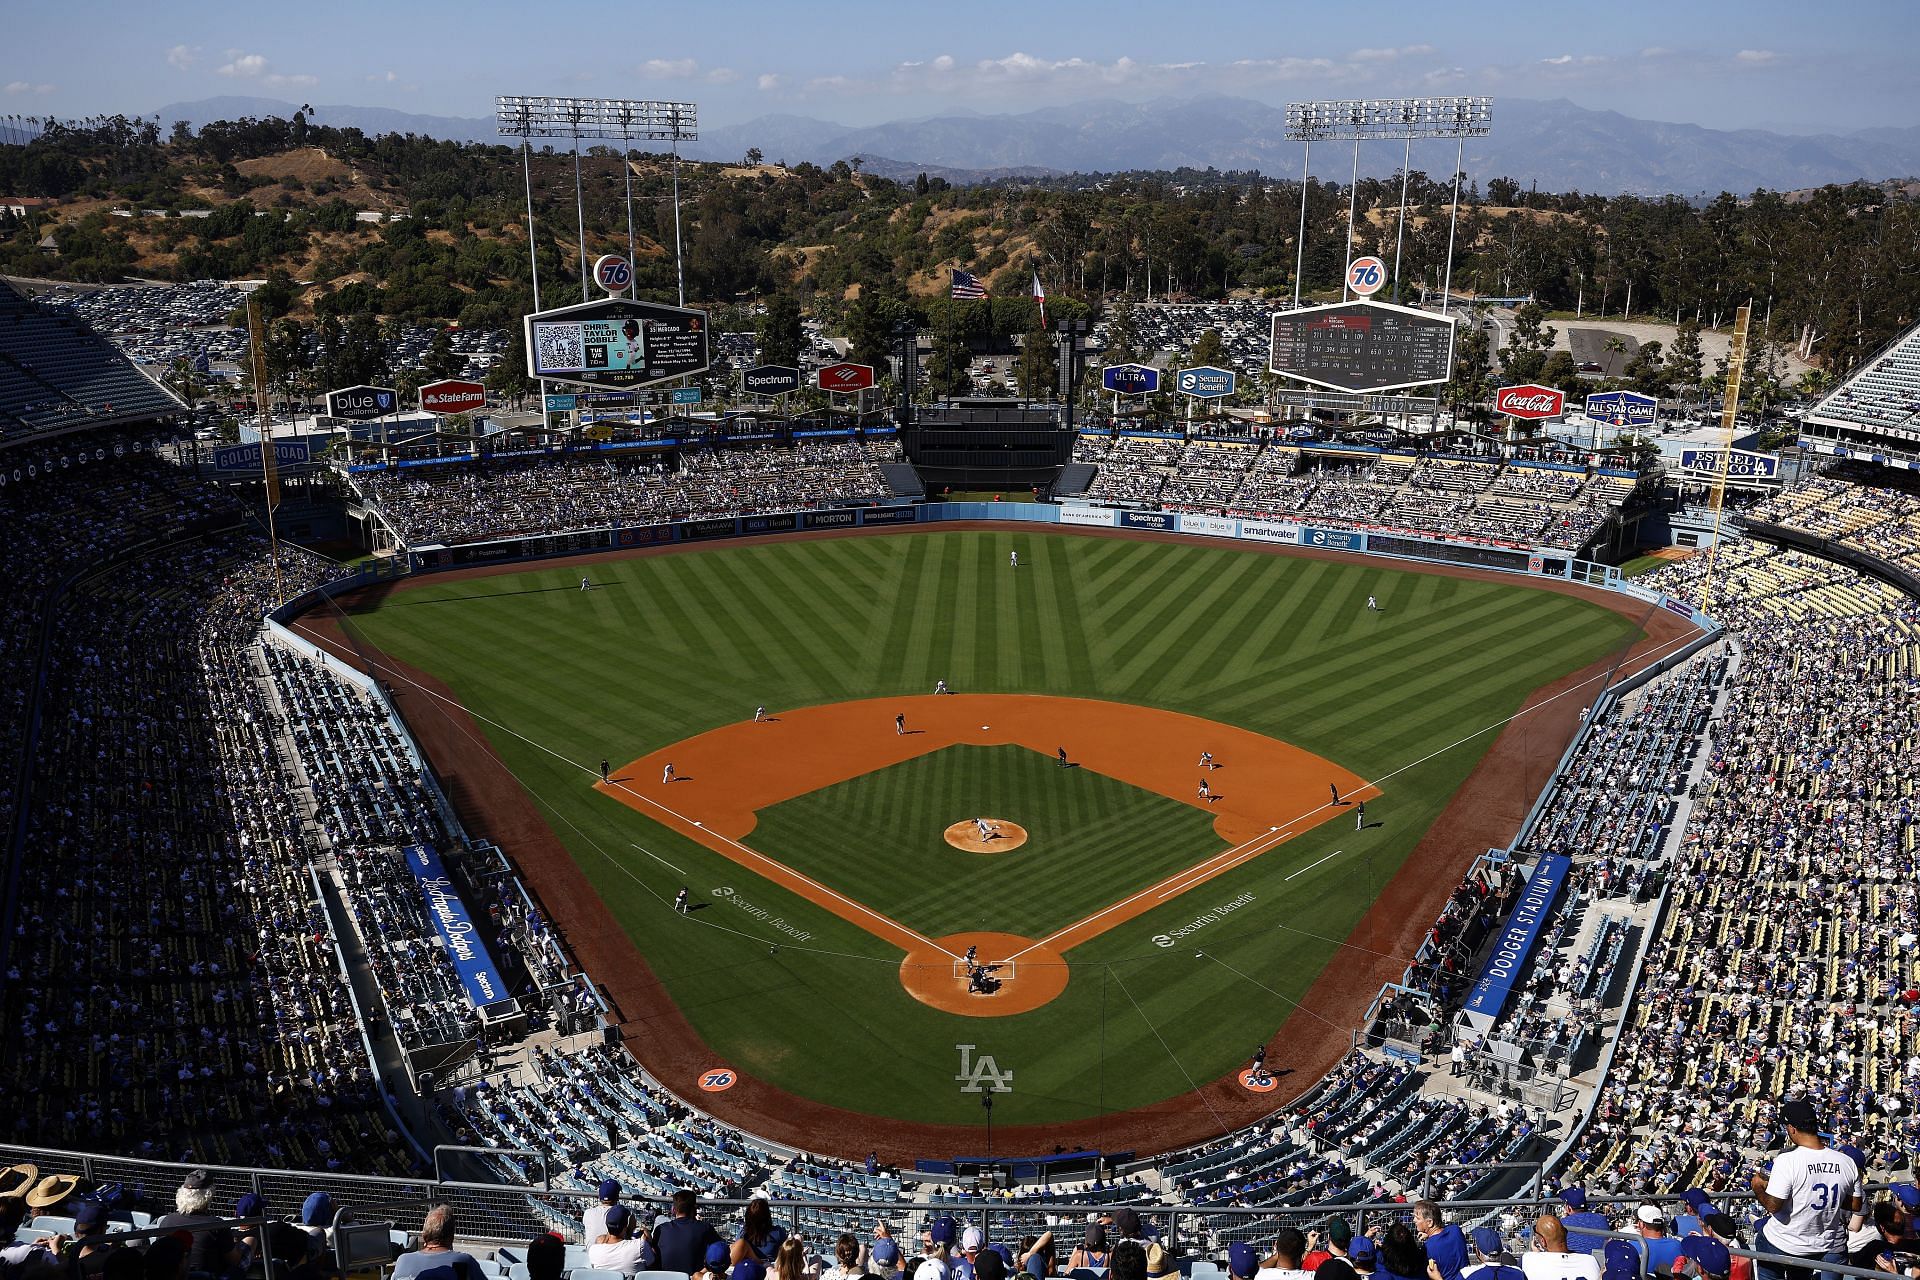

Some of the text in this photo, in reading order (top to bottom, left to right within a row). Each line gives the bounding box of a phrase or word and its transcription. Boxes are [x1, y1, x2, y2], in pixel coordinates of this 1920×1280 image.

[602, 262, 630, 284] 76
[1352, 264, 1380, 286] 76
[748, 375, 792, 386] Spectrum
[1115, 373, 1146, 382] ULTRA
[1199, 375, 1229, 384] Security
[1199, 383, 1225, 392] Benefit
[336, 395, 374, 409] blue
[1502, 392, 1556, 412] Coca-Cola
[1589, 403, 1653, 415] ALL STAR GAME
[344, 408, 378, 416] california
[220, 447, 262, 467] GOLDE
[273, 447, 304, 460] ROAD
[816, 514, 852, 523] MORTON
[1129, 514, 1162, 522] Spectrum
[1244, 527, 1296, 539] smartwater
[1327, 532, 1351, 542] Security
[1531, 560, 1541, 568] 76
[1517, 879, 1553, 924] STADIUM
[422, 877, 476, 960] Los Angeles Dodgers
[727, 894, 811, 942] Security Benefit
[1170, 892, 1256, 938] Security Benefit
[1490, 928, 1529, 978] DODGER
[475, 971, 495, 999] Spectrum
[955, 1044, 1013, 1092] LA
[703, 1072, 732, 1087] 76
[1808, 1163, 1840, 1175] PIAZZA
[1810, 1184, 1839, 1210] 31
